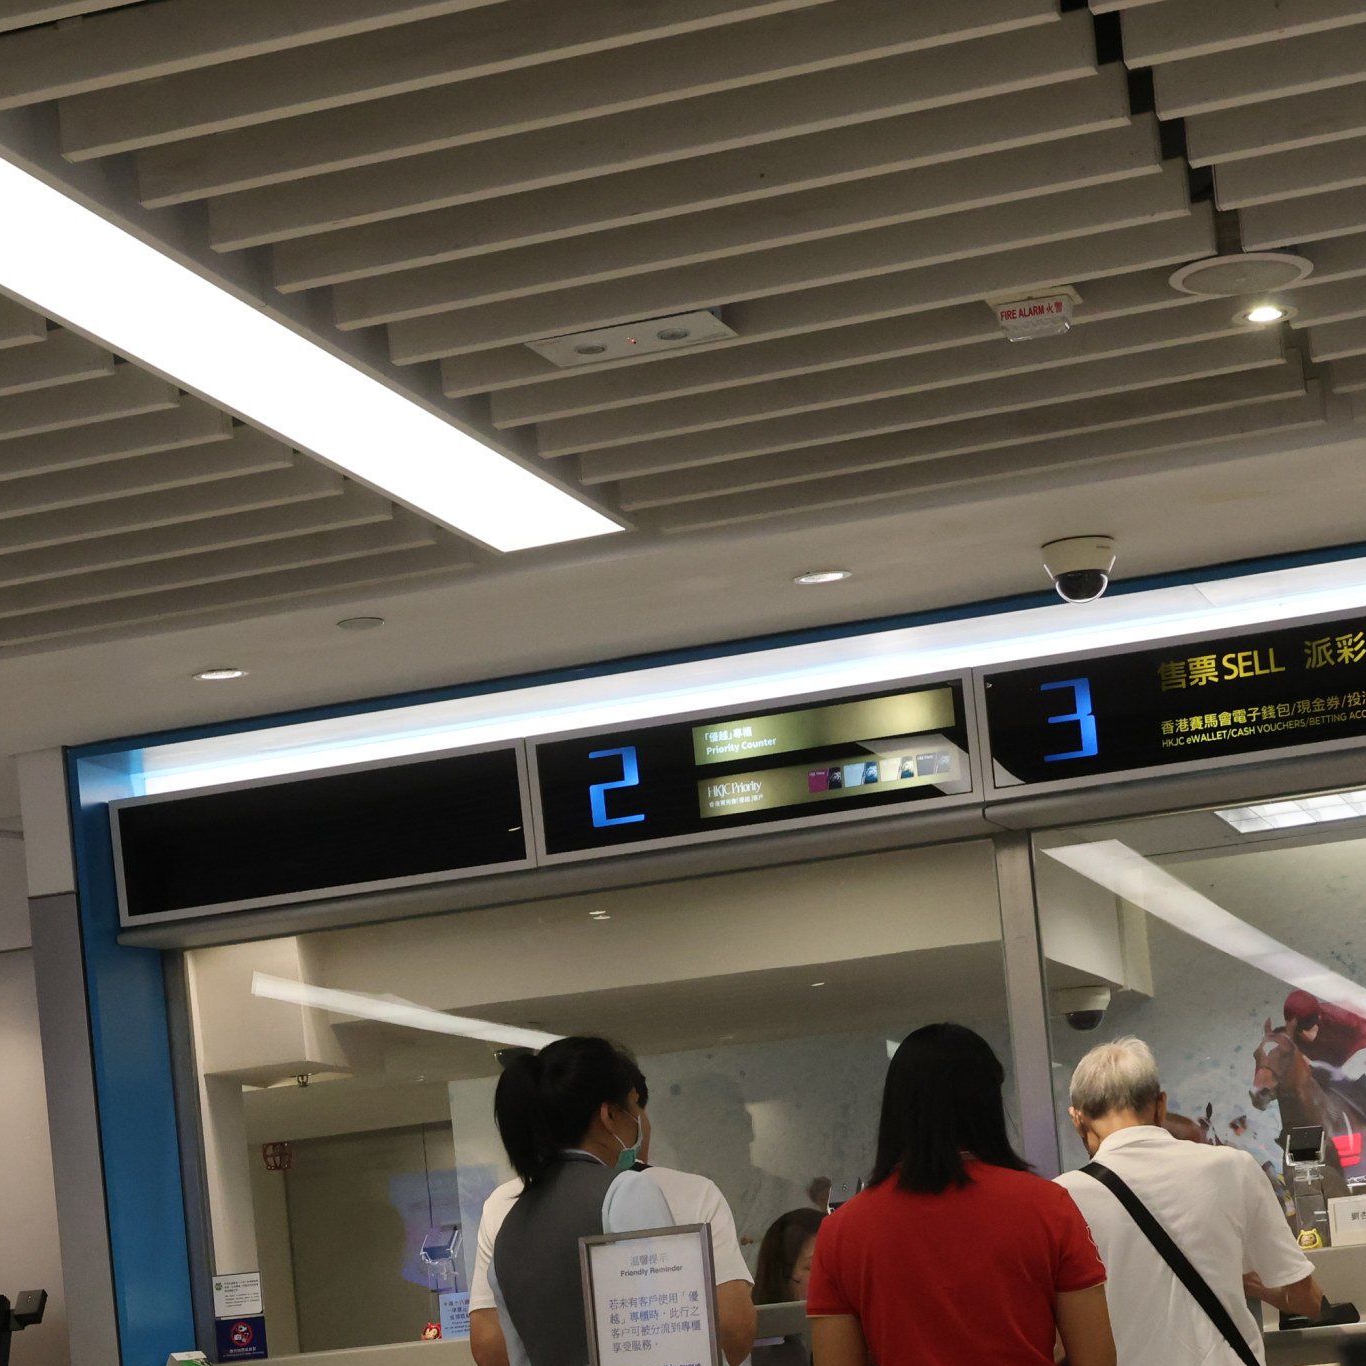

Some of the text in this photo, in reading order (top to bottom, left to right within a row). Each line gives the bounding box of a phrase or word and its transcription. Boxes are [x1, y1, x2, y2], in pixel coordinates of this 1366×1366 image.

[1000, 309, 1017, 320] FIRE
[1018, 305, 1045, 318] ALARM
[1157, 653, 1219, 692] 售票
[1222, 647, 1286, 681] SELL
[1304, 631, 1366, 670] 派彩
[1040, 678, 1099, 763] 3
[1162, 737, 1185, 748] HKJC
[1186, 726, 1256, 745] eWALLET/CASH
[1257, 712, 1347, 733] VOUCHERS/BETTING
[706, 737, 777, 756] Priority Counter
[588, 746, 645, 827] 2
[707, 780, 762, 798] HKJC Priority
[620, 1264, 683, 1277] Friendly Reminder
